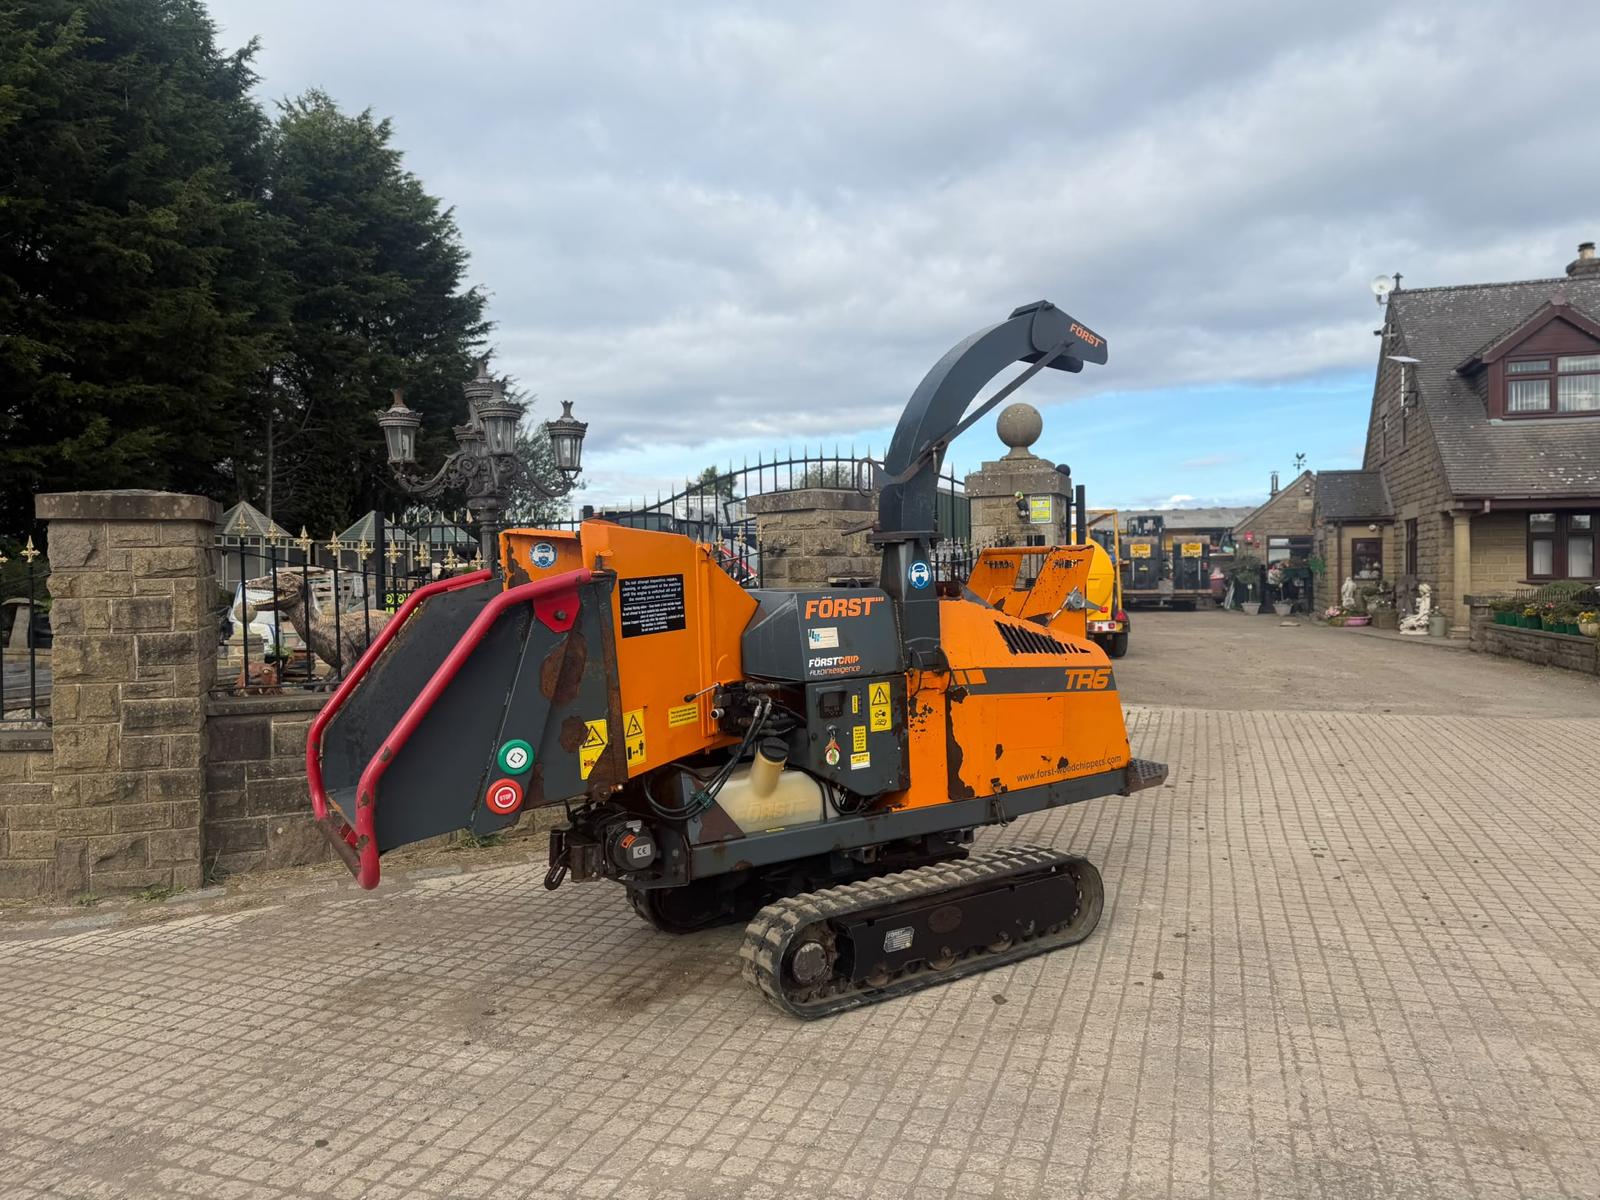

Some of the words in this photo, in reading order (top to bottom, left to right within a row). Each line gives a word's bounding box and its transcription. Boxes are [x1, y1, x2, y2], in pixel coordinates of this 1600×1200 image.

[1070, 323, 1104, 347] FÖRST
[805, 596, 884, 620] FÖRST
[808, 655, 860, 668] FÖRSTGRIP
[1064, 668, 1113, 690] TR6
[1016, 754, 1122, 783] www.forst-woodchippers.com
